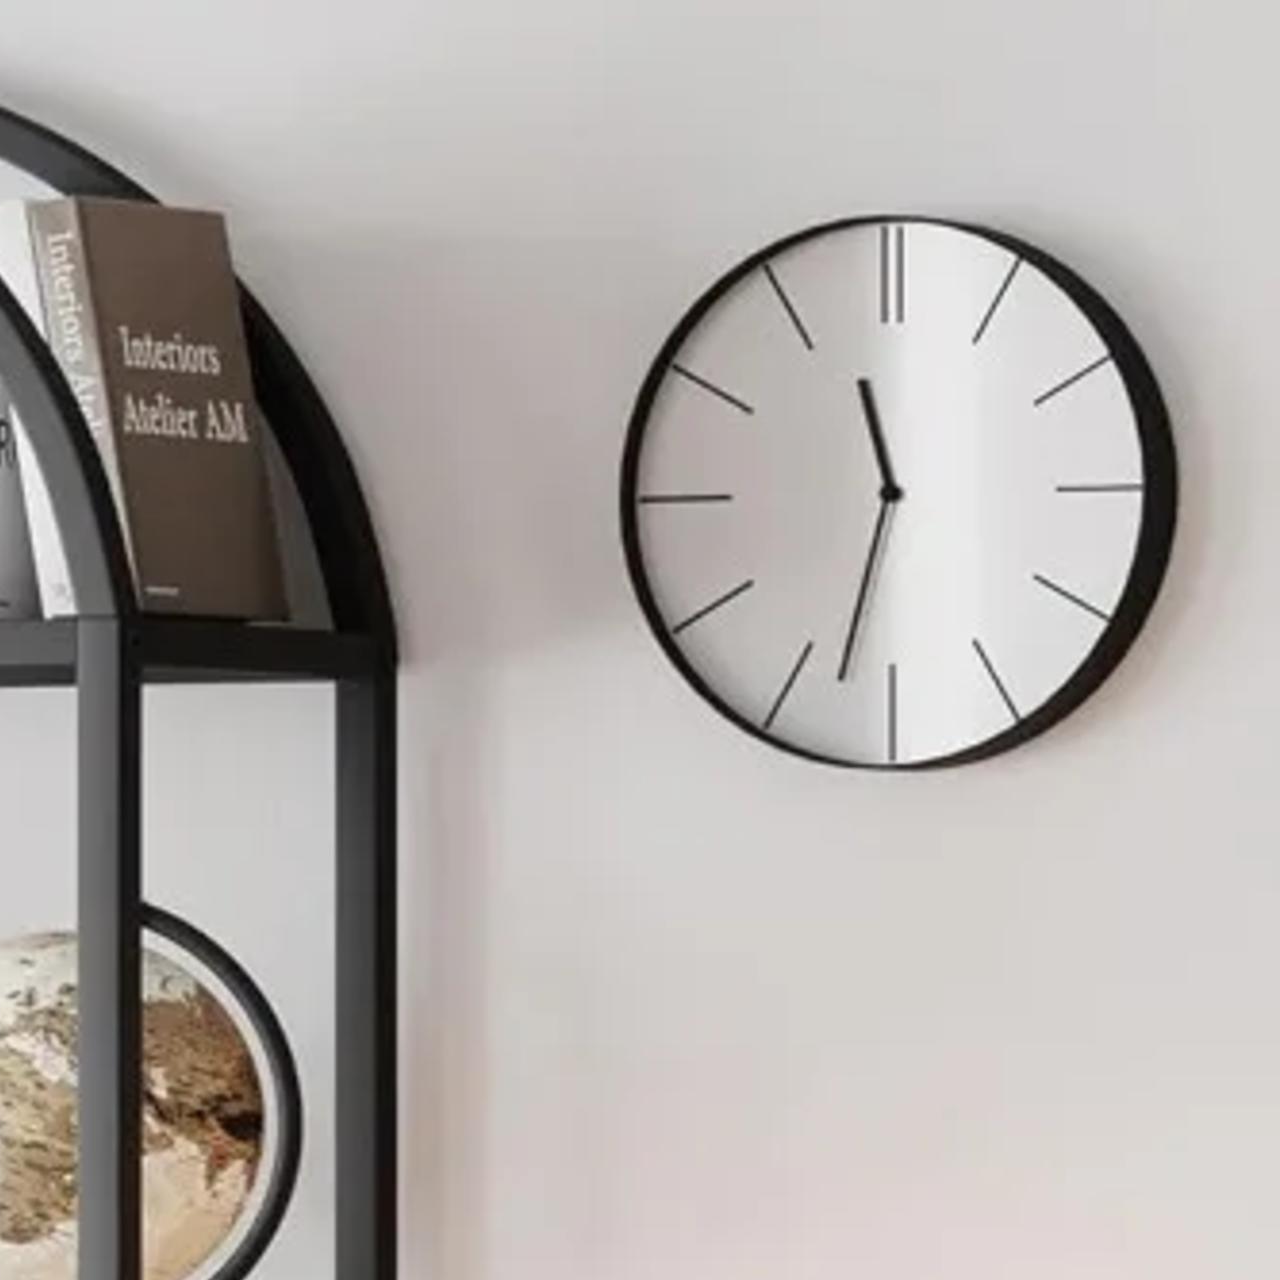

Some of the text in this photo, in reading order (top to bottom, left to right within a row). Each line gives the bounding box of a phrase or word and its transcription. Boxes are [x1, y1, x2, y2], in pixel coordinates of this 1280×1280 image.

[46, 228, 84, 366] Interiors
[119, 325, 222, 376] Interiors
[122, 393, 250, 443] Atelier AM
